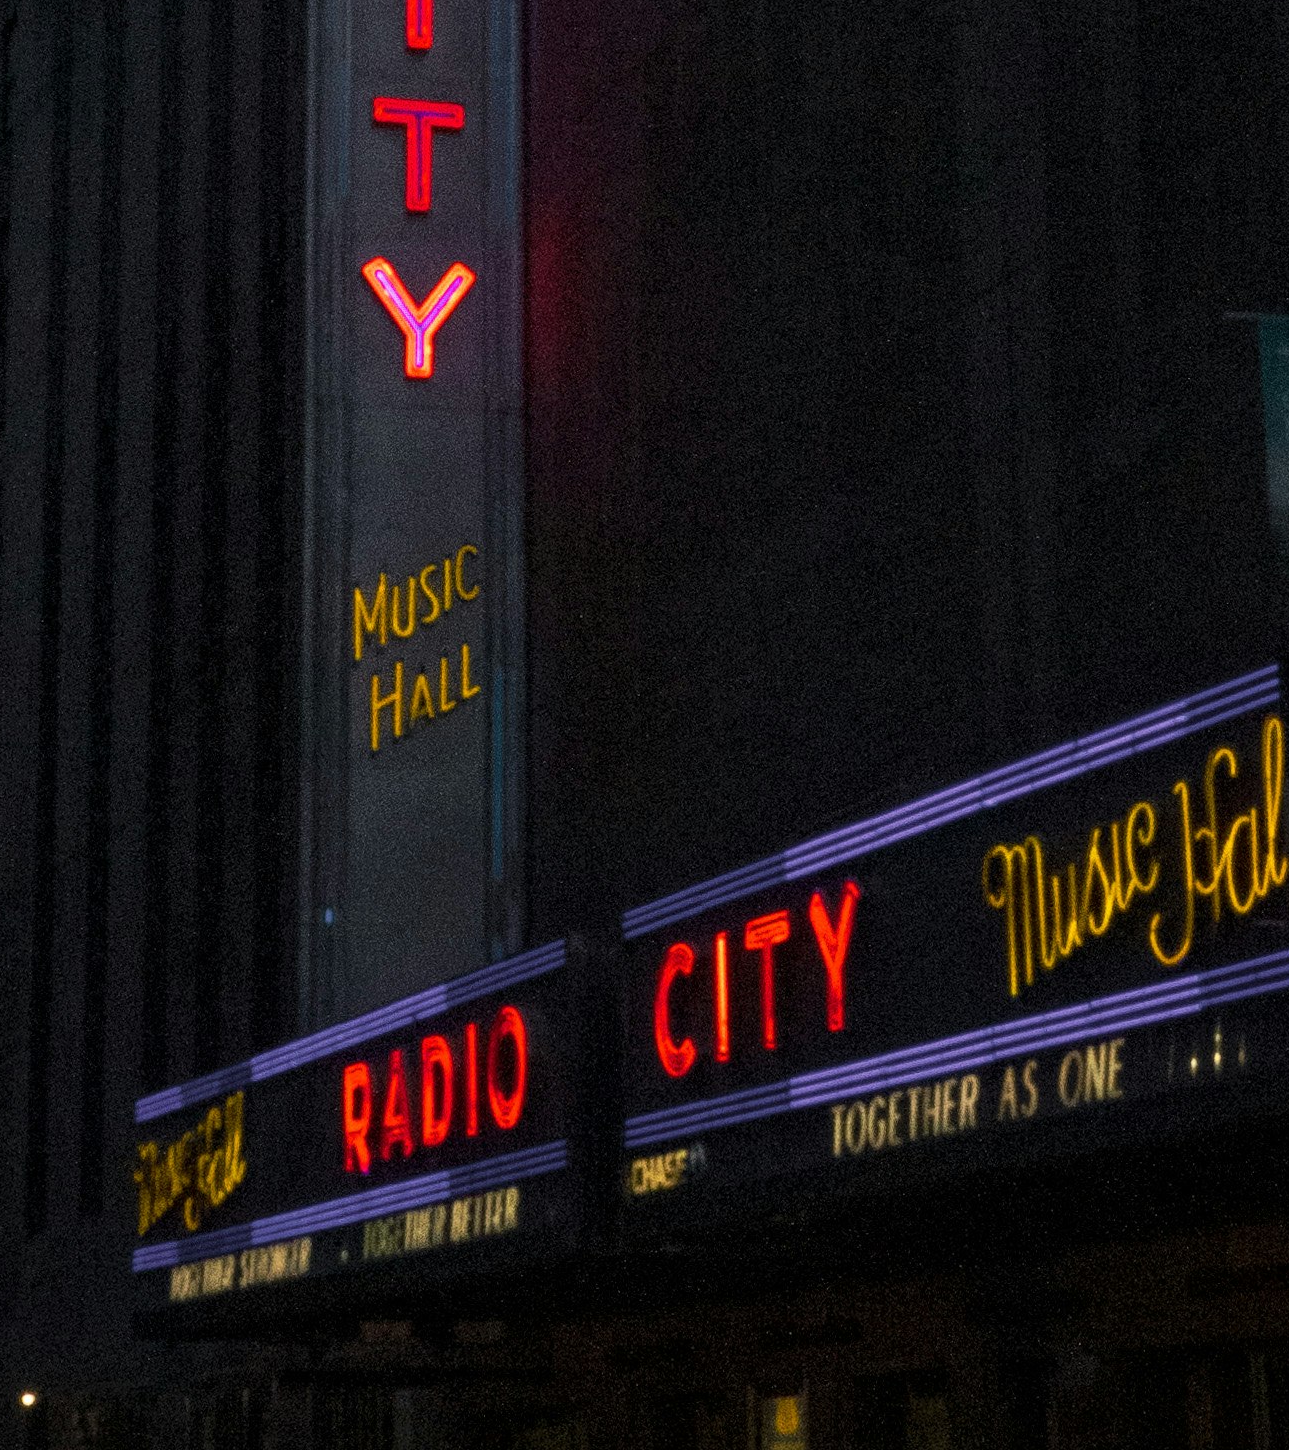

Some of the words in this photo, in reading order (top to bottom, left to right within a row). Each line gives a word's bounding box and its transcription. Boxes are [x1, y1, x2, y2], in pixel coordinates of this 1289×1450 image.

[352, 544, 481, 661] MUSIC
[368, 643, 482, 753] HALL
[653, 879, 862, 1080] CITY
[982, 801, 1159, 998] Music
[342, 1004, 529, 1175] RADIO
[829, 1072, 981, 1158] TOGETHER
[998, 1059, 1040, 1120] AS
[1057, 1037, 1125, 1106] ONE
